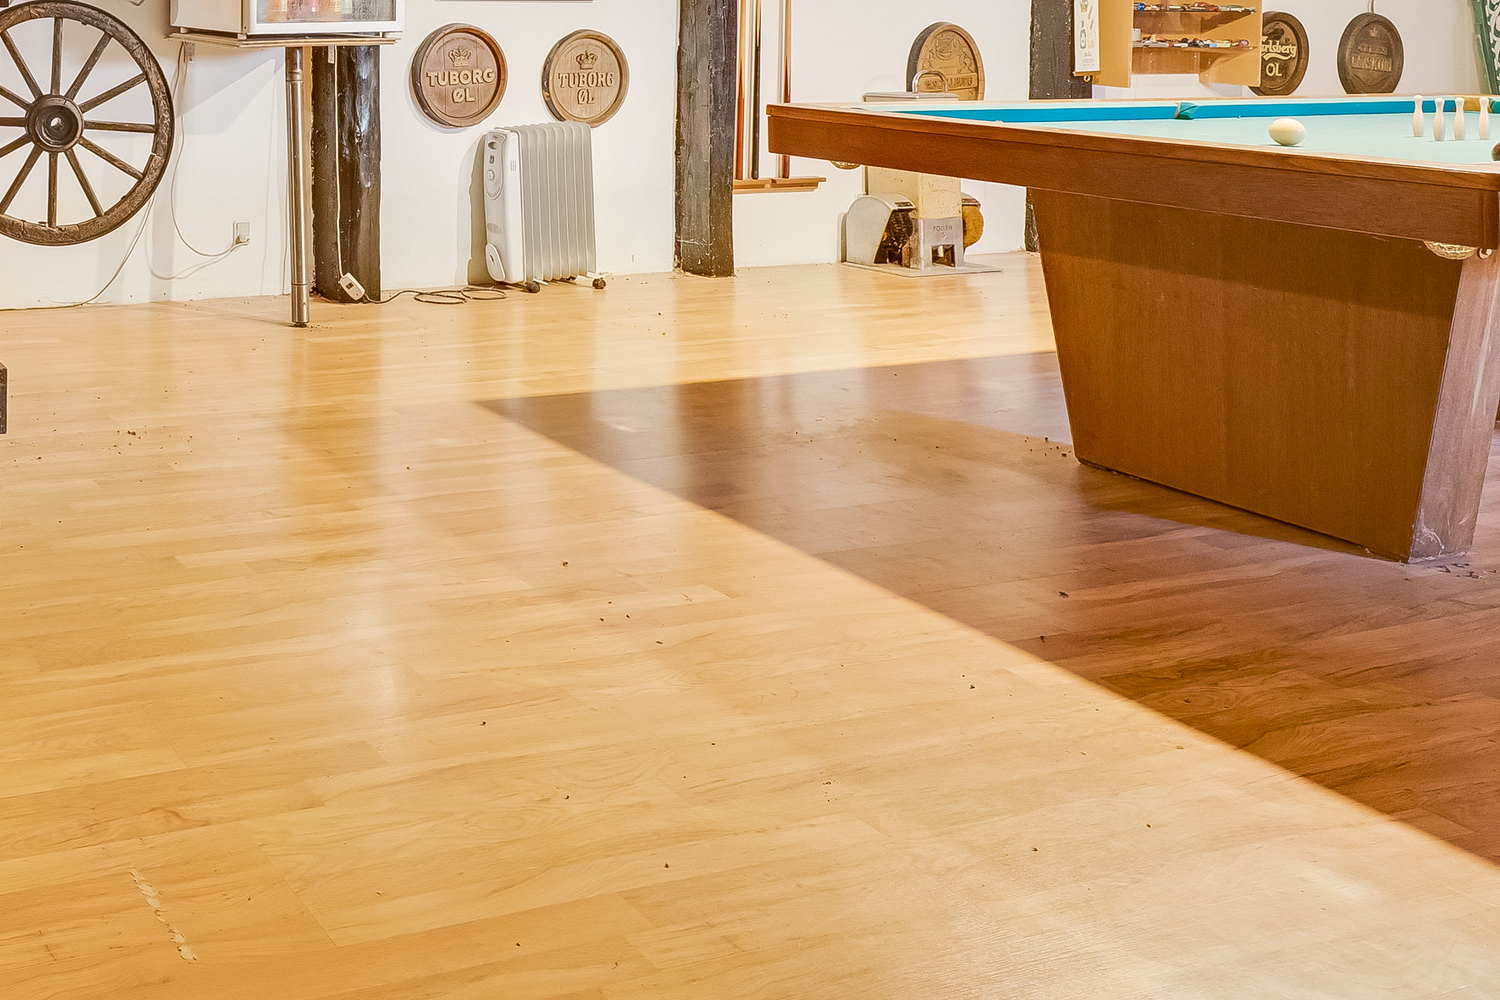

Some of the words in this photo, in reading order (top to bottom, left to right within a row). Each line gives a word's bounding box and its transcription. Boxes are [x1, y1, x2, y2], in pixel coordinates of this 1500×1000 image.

[426, 68, 496, 87] TUBORG
[558, 71, 614, 88] TUBORG
[452, 88, 476, 104] ØL
[576, 89, 596, 105] ØL
